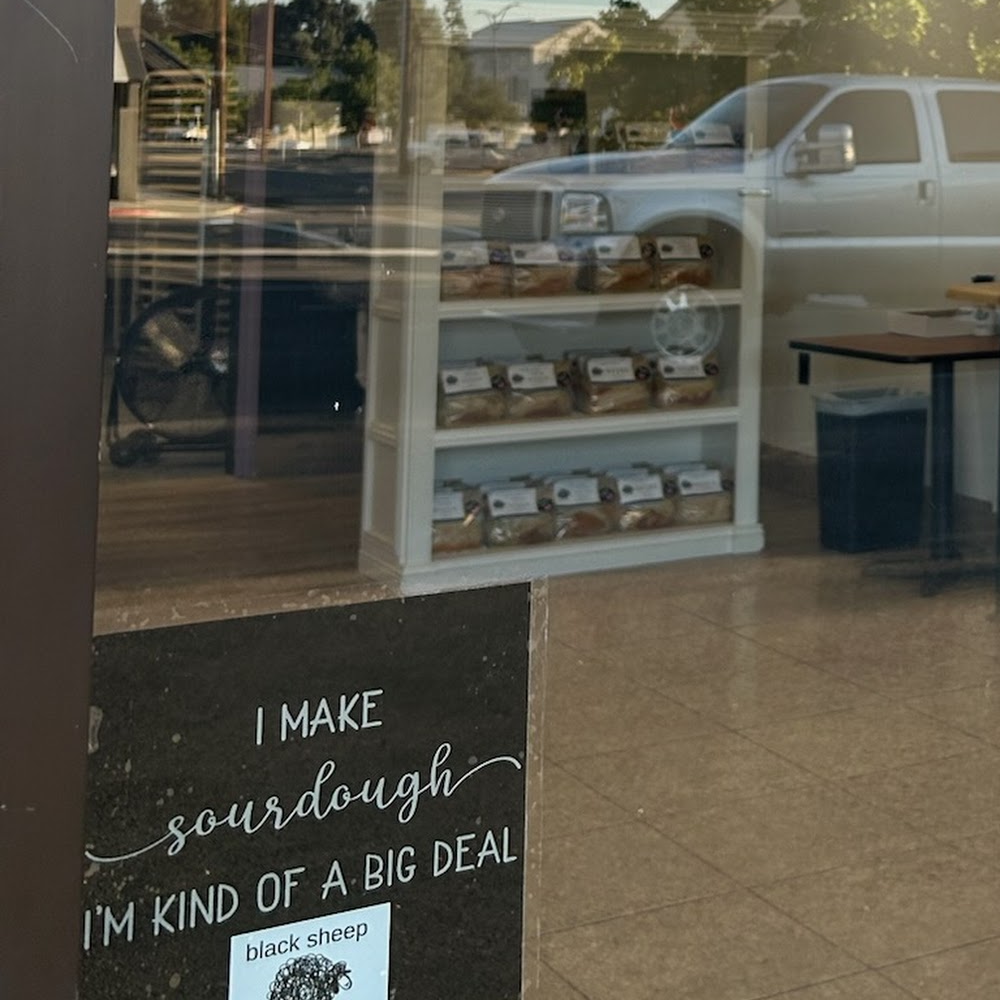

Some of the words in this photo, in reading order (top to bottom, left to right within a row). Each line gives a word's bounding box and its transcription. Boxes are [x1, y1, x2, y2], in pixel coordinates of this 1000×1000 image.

[256, 706, 264, 745] I
[280, 688, 384, 742] MAKE
[85, 742, 522, 863] sourdough
[83, 902, 136, 951] I'M
[152, 882, 239, 936] KIND
[256, 867, 306, 913] OF
[321, 860, 348, 900] A
[364, 845, 416, 891] BIG
[433, 827, 518, 878] DEAL
[246, 933, 300, 962] black
[306, 922, 368, 948] sheep
